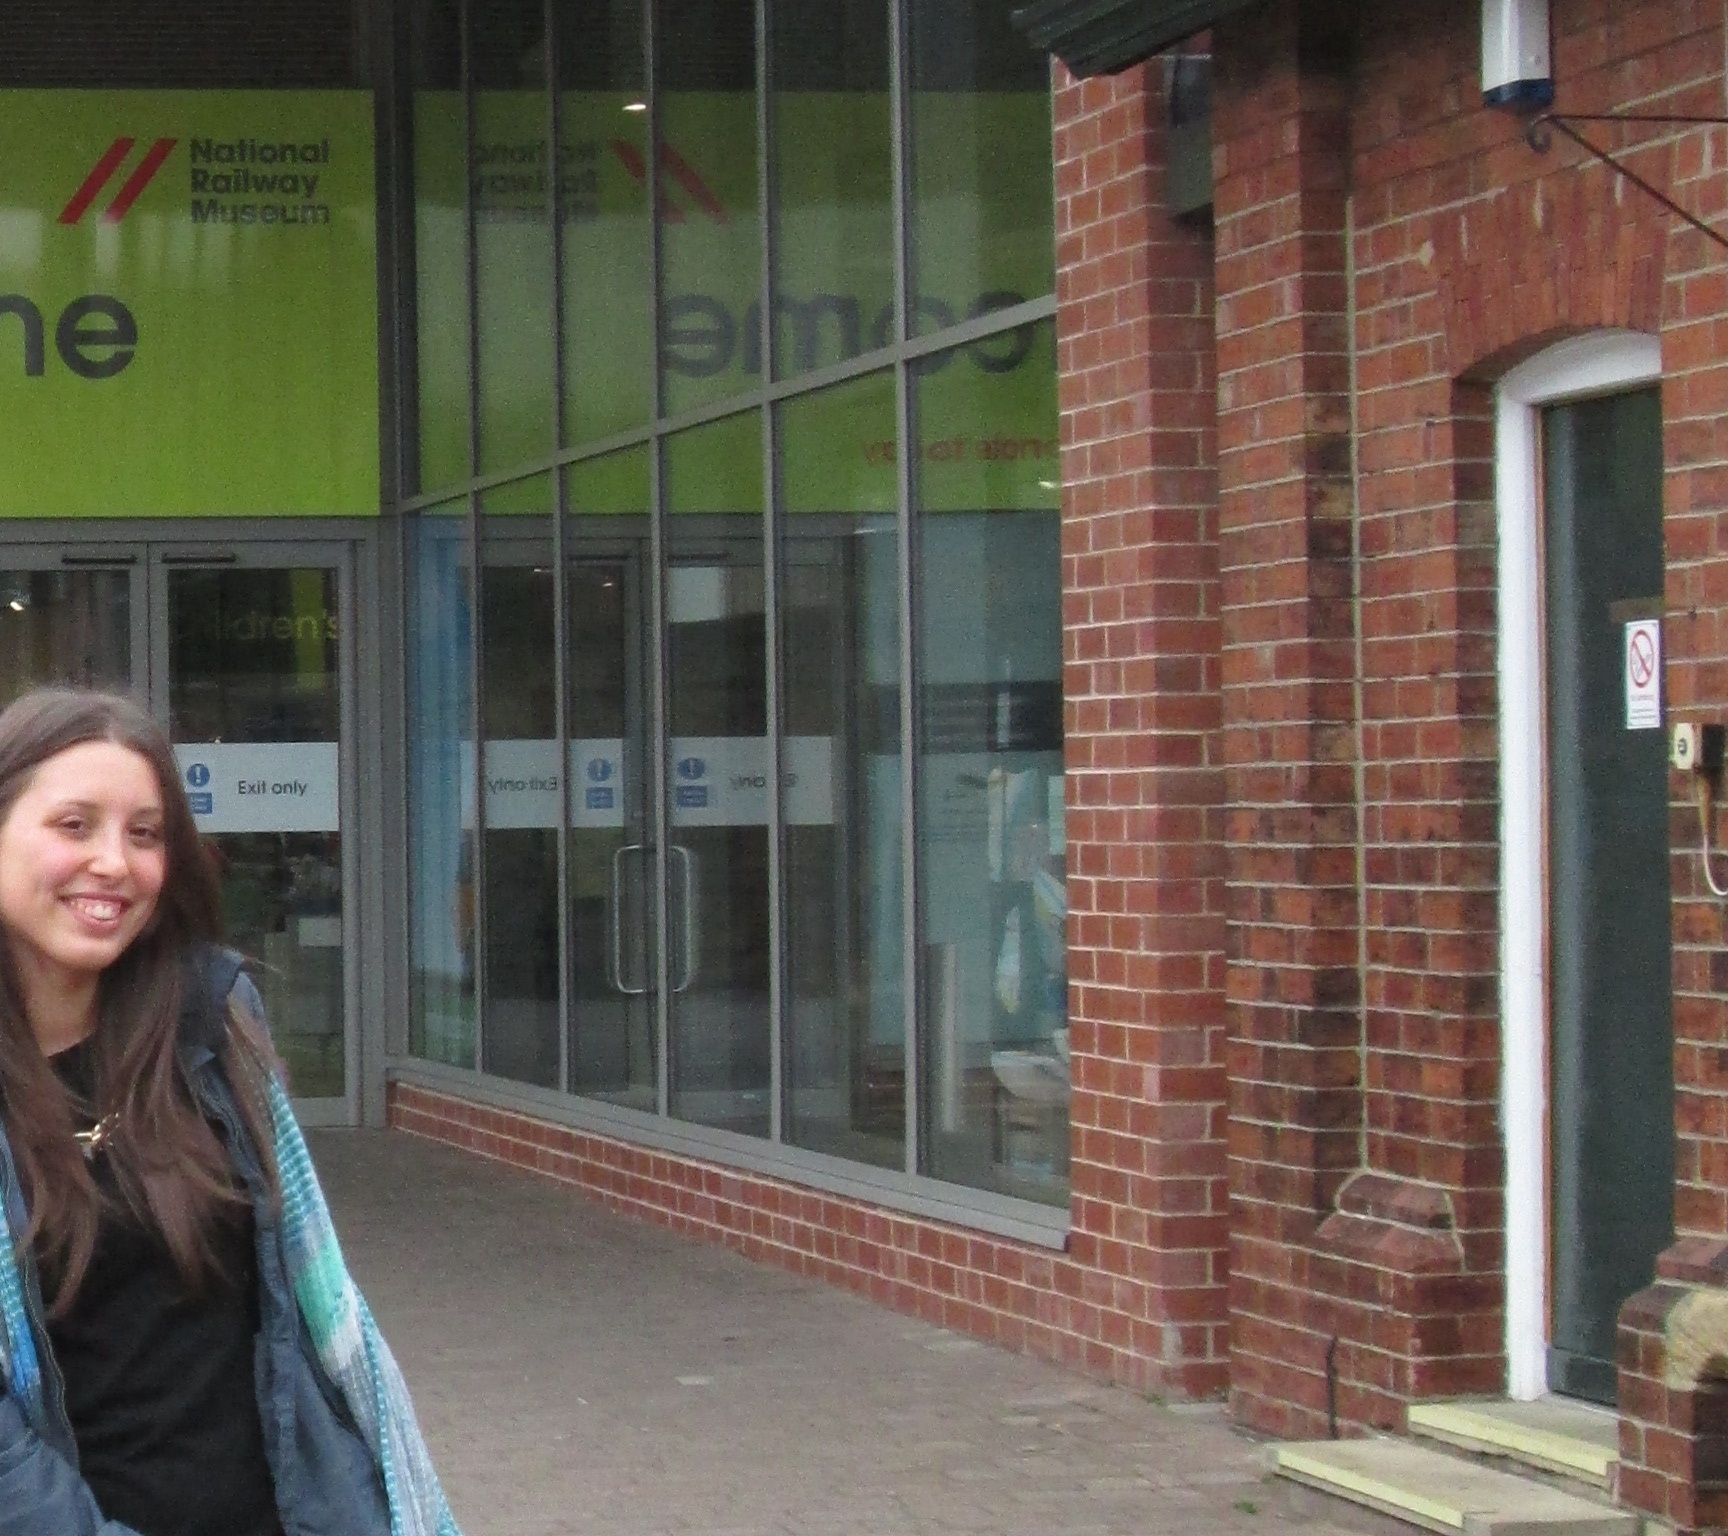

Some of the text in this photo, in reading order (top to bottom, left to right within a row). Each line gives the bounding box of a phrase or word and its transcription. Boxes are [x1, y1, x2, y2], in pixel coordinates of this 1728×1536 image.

[190, 138, 329, 163] National
[191, 168, 319, 198] Railway
[191, 199, 329, 224] Museum
[238, 780, 308, 797] Exit only
